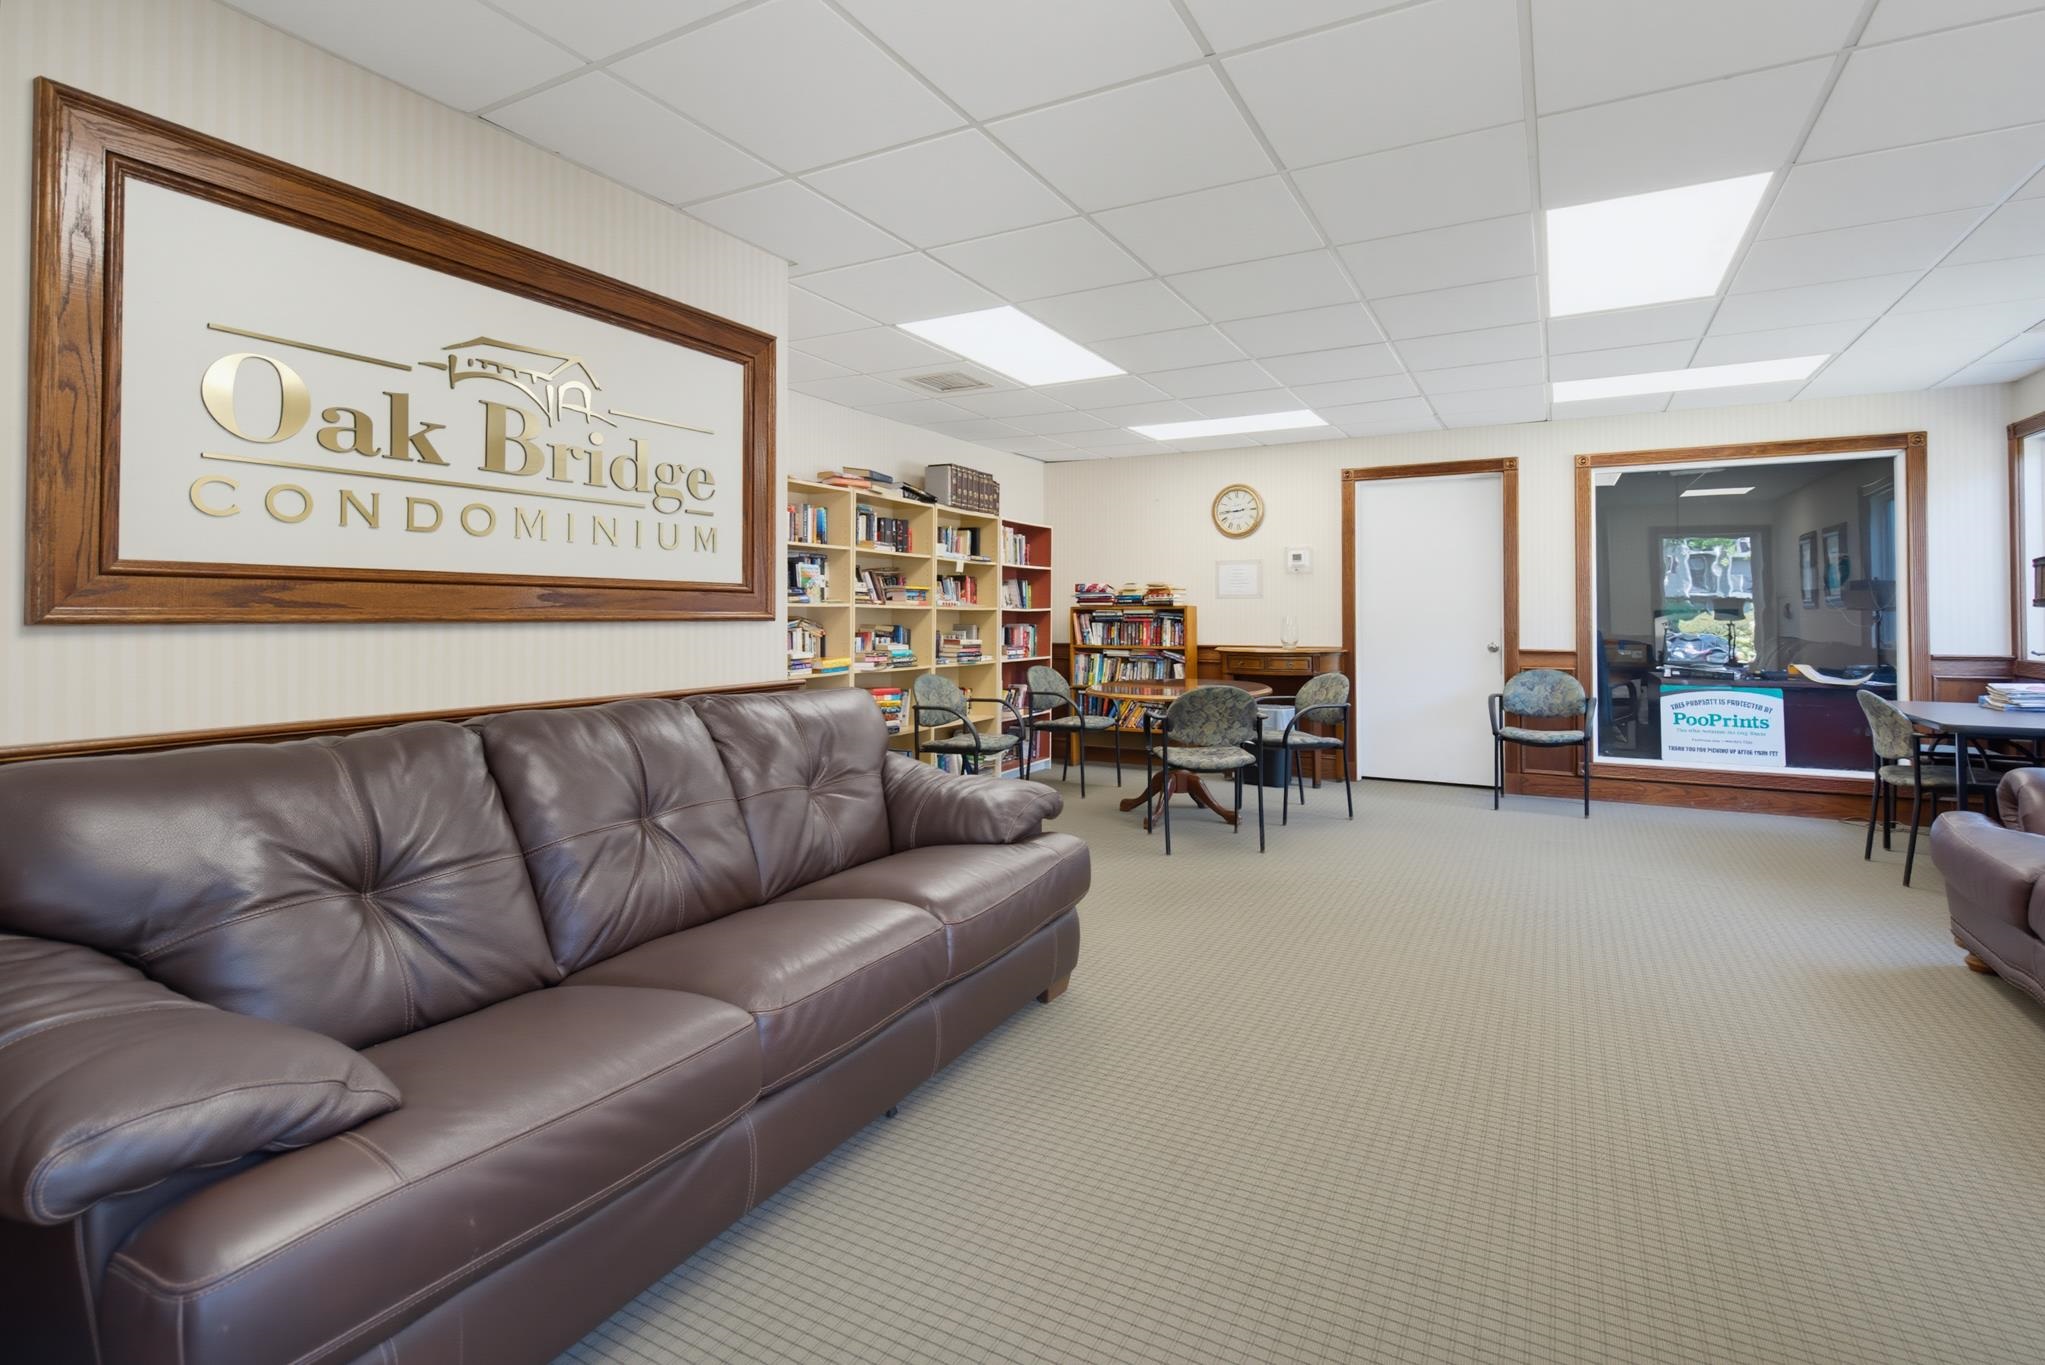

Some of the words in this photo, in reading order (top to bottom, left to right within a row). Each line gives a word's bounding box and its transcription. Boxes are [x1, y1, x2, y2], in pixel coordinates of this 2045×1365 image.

[200, 352, 450, 466] Oak
[478, 399, 715, 514] Bridge
[189, 474, 718, 553] CONDOMINIUM
[1673, 712, 1769, 729] PooPrints
